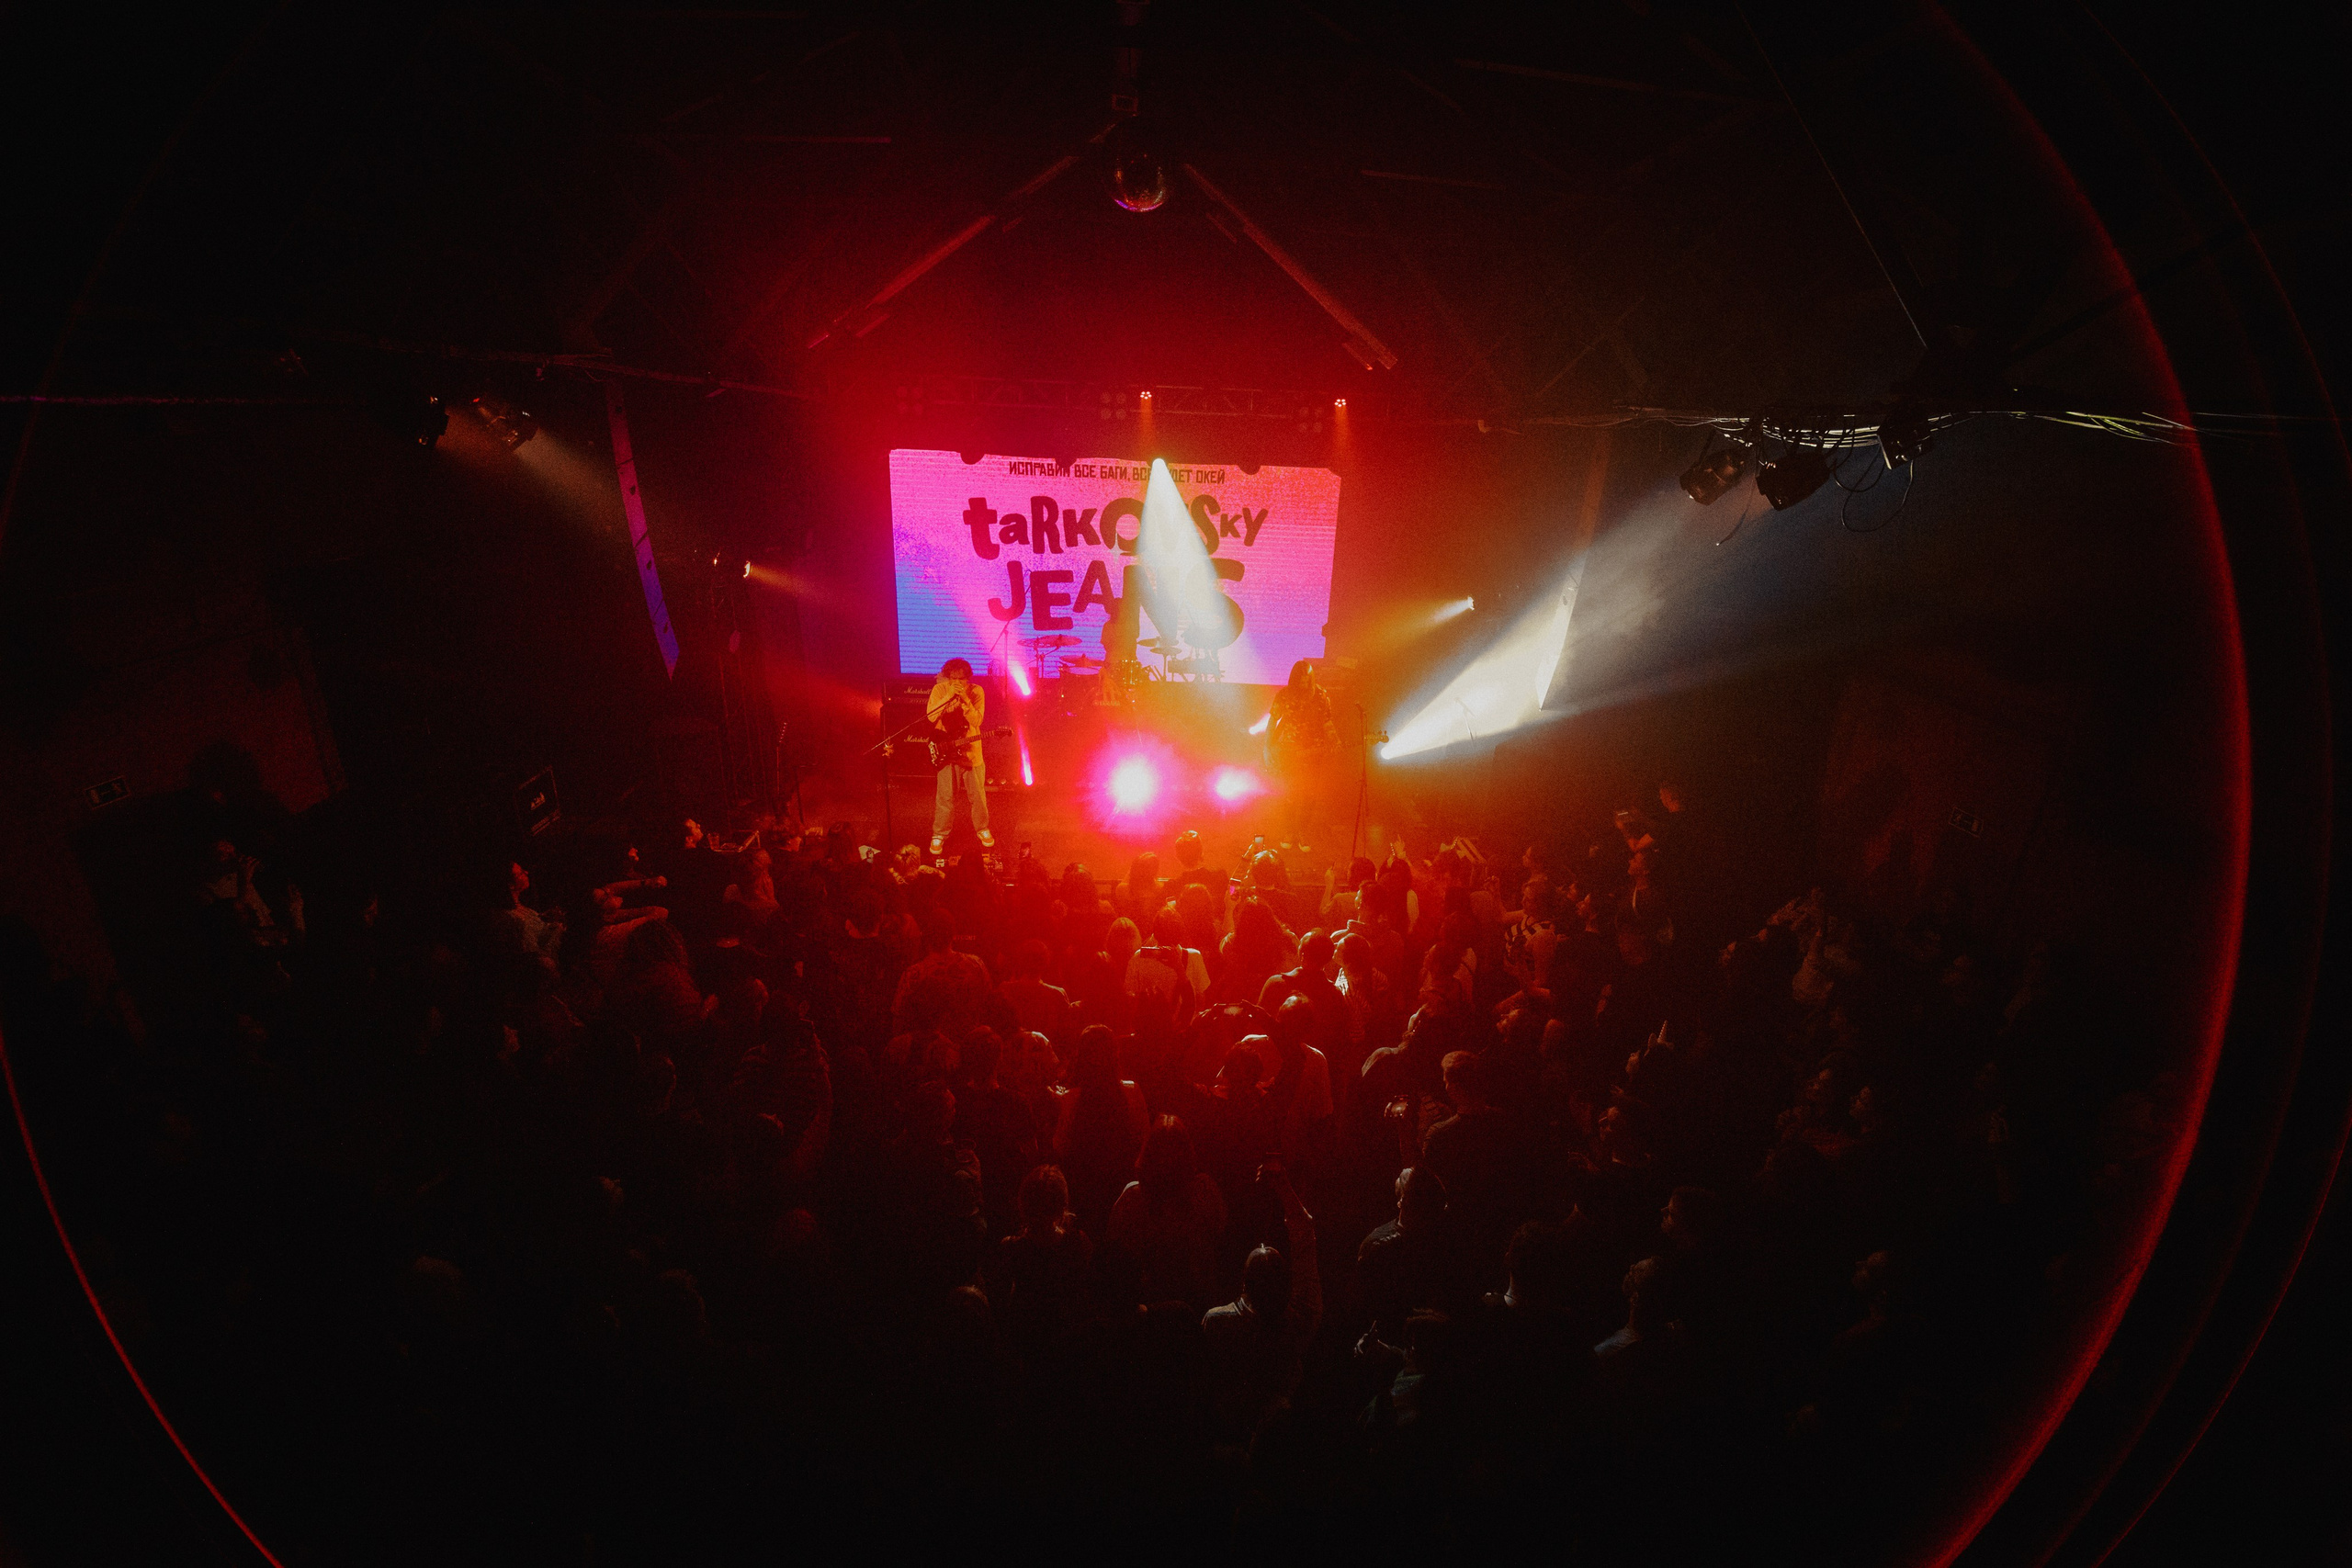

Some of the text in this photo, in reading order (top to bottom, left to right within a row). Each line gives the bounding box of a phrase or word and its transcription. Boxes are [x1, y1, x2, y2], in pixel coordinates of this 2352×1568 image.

[1074, 464, 1096, 478] ВСЕ
[1100, 466, 1130, 482] БАГИ,
[1196, 468, 1226, 484] ОКЕЙ
